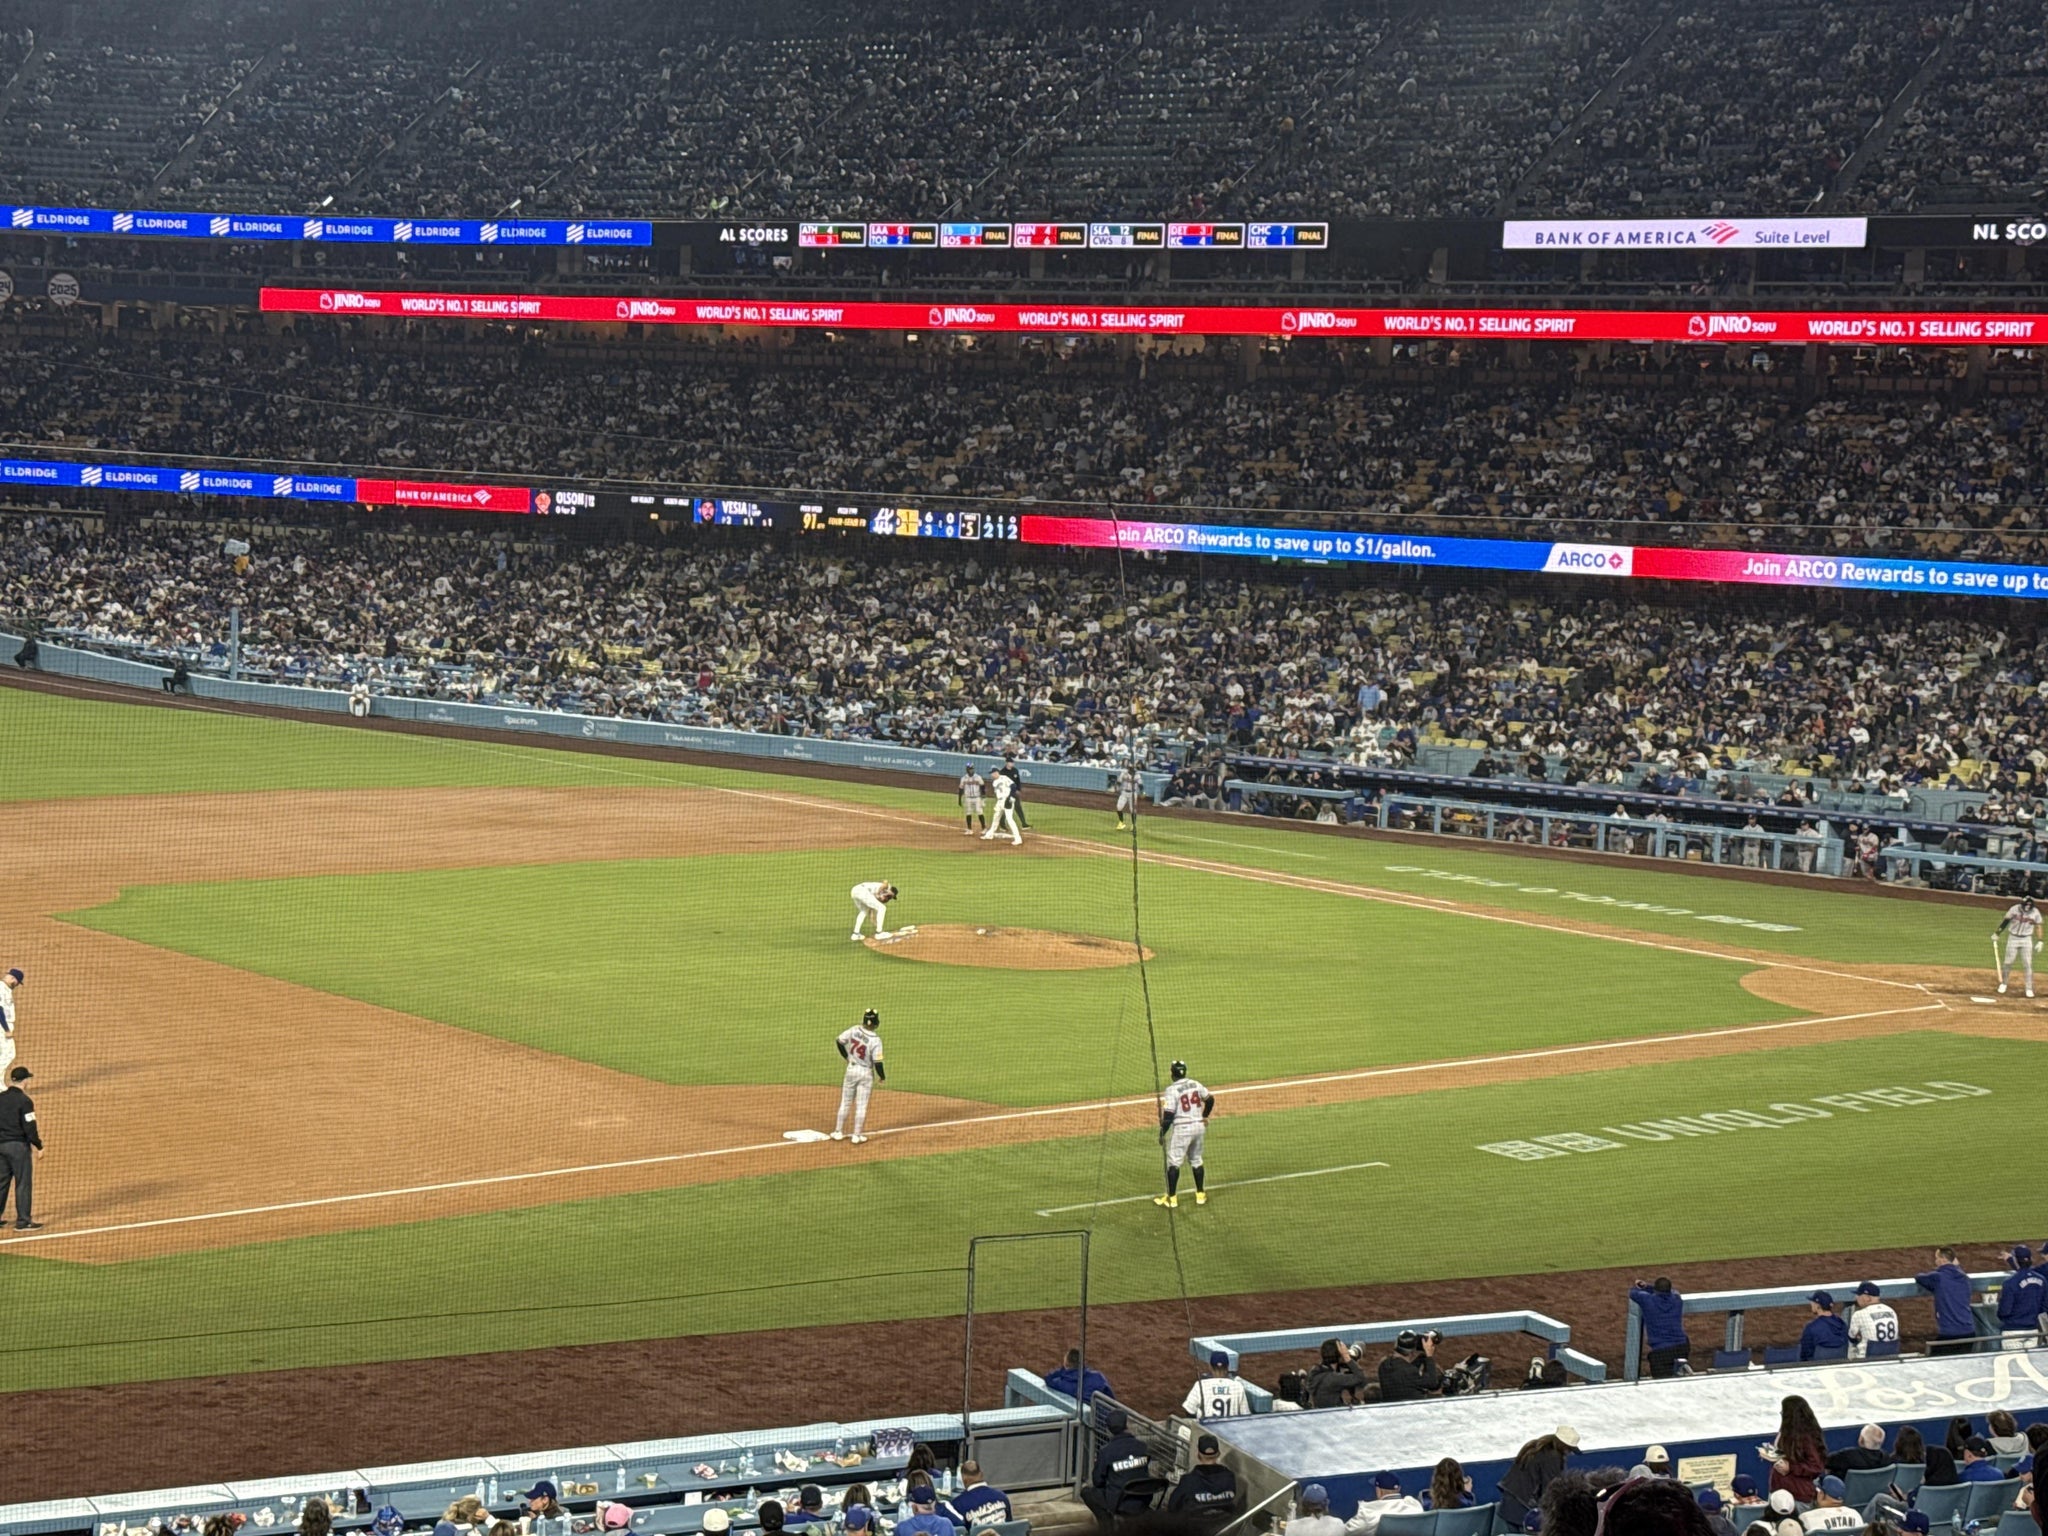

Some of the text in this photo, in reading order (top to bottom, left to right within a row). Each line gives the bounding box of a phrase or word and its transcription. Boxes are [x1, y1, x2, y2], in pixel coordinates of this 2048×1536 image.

[37, 214, 90, 225] ELDRIDGE
[136, 218, 188, 229] ELDRIDGE
[233, 222, 282, 233] ELDRIDGE
[325, 224, 373, 235] ELDRIDGE
[415, 226, 461, 237] ELDRIDGE
[501, 227, 546, 238] ELDRIDGE
[587, 228, 632, 239] ELDRIDGE
[801, 226, 833, 234] ATH 4
[871, 226, 904, 235] LAA 0
[1017, 226, 1051, 235] MIN 4
[1092, 226, 1130, 235] SEA 12
[1170, 226, 1206, 235] DET 3
[1251, 226, 1288, 235] CHC 7
[1973, 224, 1999, 240] NL
[719, 228, 788, 242] AL SCORES
[801, 236, 833, 244] BAL 3
[841, 231, 861, 240] FINAL
[871, 236, 904, 245] TOR 2
[912, 231, 933, 240] FINAL
[943, 236, 976, 245] BOS 2
[985, 231, 1006, 241] FINAL
[1017, 236, 1051, 245] CLE 6
[1060, 231, 1081, 241] FINAL
[1092, 236, 1127, 245] CWS 8
[1136, 231, 1159, 241] FINAL
[1170, 236, 1206, 245] KC 4
[1216, 231, 1239, 241] FINAL
[1297, 231, 1321, 241] FINAL
[1535, 230, 1830, 244] BANK OF AMERICA Suite Level
[1250, 237, 1287, 246] TEX 1
[50, 284, 77, 296] 2025
[333, 293, 364, 310] JINRO
[401, 298, 444, 312] WORLD'S
[471, 300, 508, 313] SELLING
[511, 301, 541, 313] SPIRIT
[629, 301, 659, 319] JINRO
[696, 305, 741, 319] WORLD'S
[770, 308, 810, 321] SELLING
[812, 309, 844, 322] SPIRIT
[943, 307, 976, 326] JINRO
[1018, 311, 1069, 325] WORLD'S
[1100, 313, 1146, 327] SELLING
[1149, 314, 1185, 328] SPIRIT
[1298, 312, 1335, 331] JINRO
[1384, 315, 1442, 331] WORLD'S
[1479, 317, 1531, 332] SELLING
[1534, 318, 1576, 333] SPIRIT
[1707, 315, 1751, 337] JINRO
[1808, 319, 1876, 336] WORLD'S
[1919, 321, 1982, 337] SELLING
[1985, 321, 2035, 337] SPIRIT
[4, 467, 58, 478] ELDRIDGE
[105, 472, 158, 484] ELDRIDGE
[203, 477, 253, 489] ELDRIDGE
[295, 482, 342, 494] ELDRIDGE
[395, 490, 473, 503] BANK OF AMERICA
[555, 491, 584, 505] OLSON
[570, 507, 576, 515] 2
[722, 501, 747, 515] VESIA
[802, 513, 817, 529] 91
[925, 512, 932, 522] 6
[946, 512, 954, 523] 0
[925, 524, 932, 535] 3
[946, 525, 954, 537] 0
[966, 522, 973, 536] 5
[984, 524, 1018, 539] 2 1 2
[1142, 528, 1182, 544] ARCO
[1187, 530, 1252, 548] Rewards
[1256, 534, 1269, 549] to
[1274, 537, 1309, 551] save
[1313, 539, 1332, 555] up
[1336, 538, 1351, 552] to
[1355, 537, 1436, 559] $1/gallon.
[1558, 552, 1606, 568] ARCO
[1742, 557, 1781, 576] Join
[1784, 559, 1837, 579] ARCO
[1841, 563, 1924, 584] Rewards
[1929, 568, 1948, 585] to
[1952, 572, 1998, 588] save
[2003, 574, 2028, 592] up
[850, 1038, 867, 1059] 74
[1180, 1090, 1201, 1112] 84
[1602, 1081, 1992, 1141] UNIQLO FIELD
[1875, 1321, 1896, 1341] 68
[1212, 1397, 1231, 1417] 91
[1824, 1515, 1856, 1530] OHTANI
